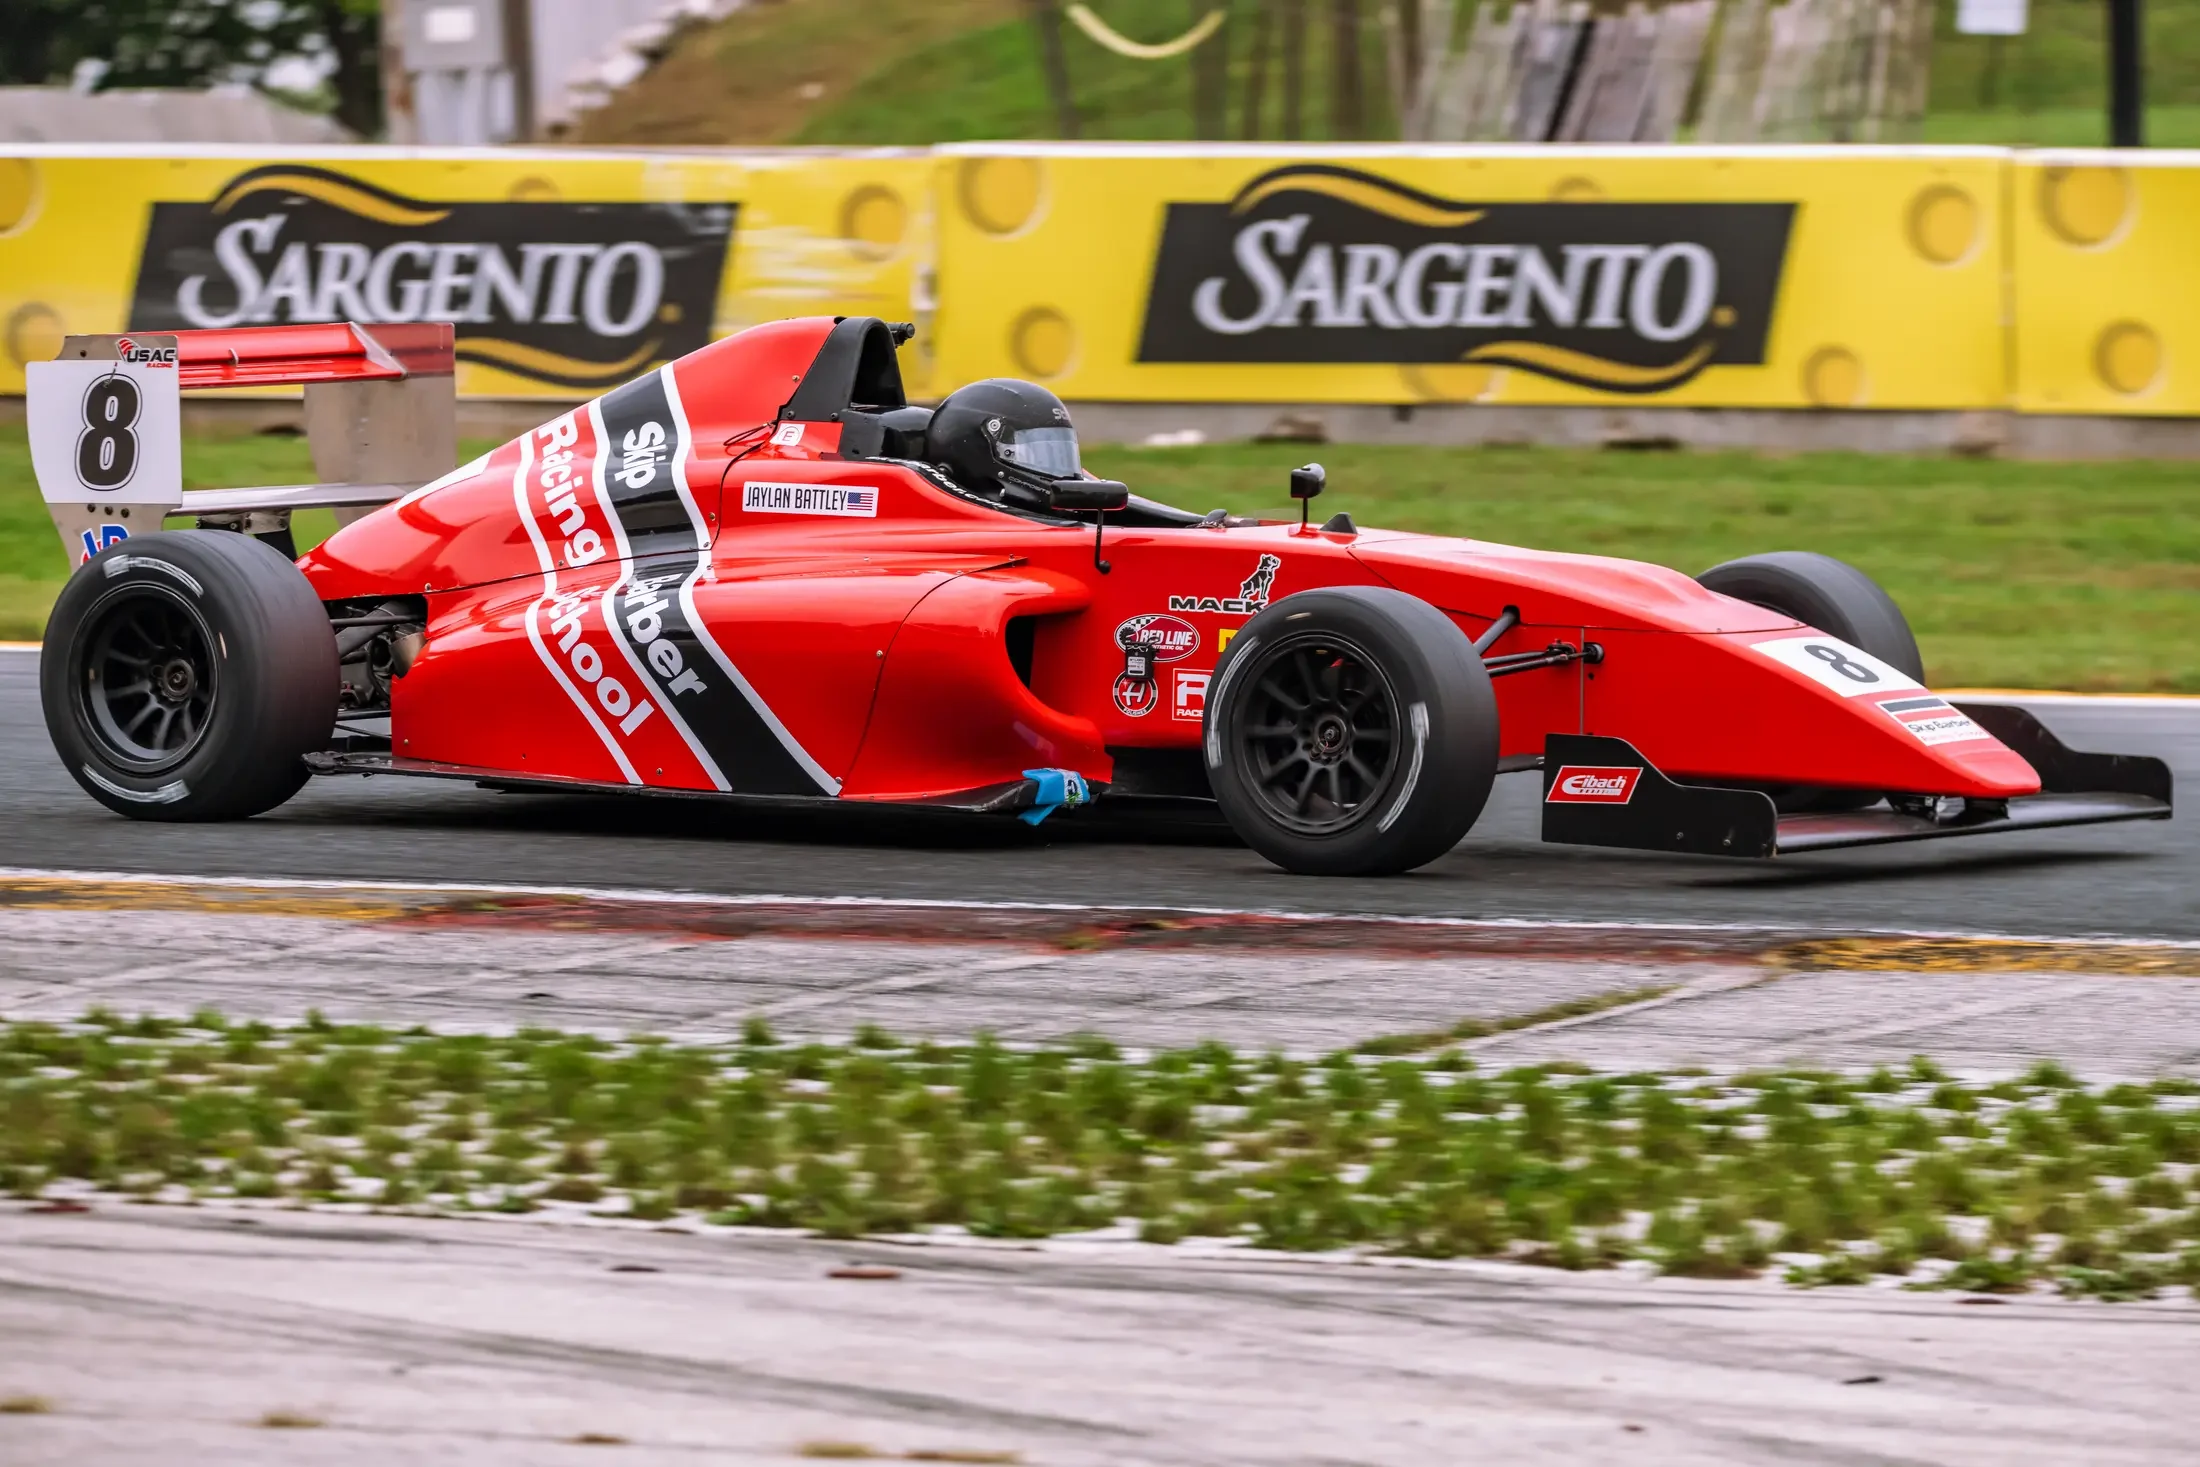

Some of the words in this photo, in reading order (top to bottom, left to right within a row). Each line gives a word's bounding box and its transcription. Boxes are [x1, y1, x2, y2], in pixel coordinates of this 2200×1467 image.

[178, 211, 666, 337] SARGENTO
[1193, 213, 1718, 341] SARGENTO
[127, 347, 176, 363] USAC
[74, 373, 142, 491] 8
[614, 421, 666, 490] Skip
[538, 412, 606, 568] Racing
[745, 486, 791, 508] JAYLAN
[795, 487, 847, 511] BATTLEY
[1170, 596, 1267, 613] MACK
[623, 572, 708, 698] Barber
[1140, 629, 1164, 644] RED
[1804, 645, 1880, 683] 8
[1908, 723, 1936, 732] Skip
[1933, 720, 1970, 729] Barber
[1562, 774, 1627, 796] Eibach
